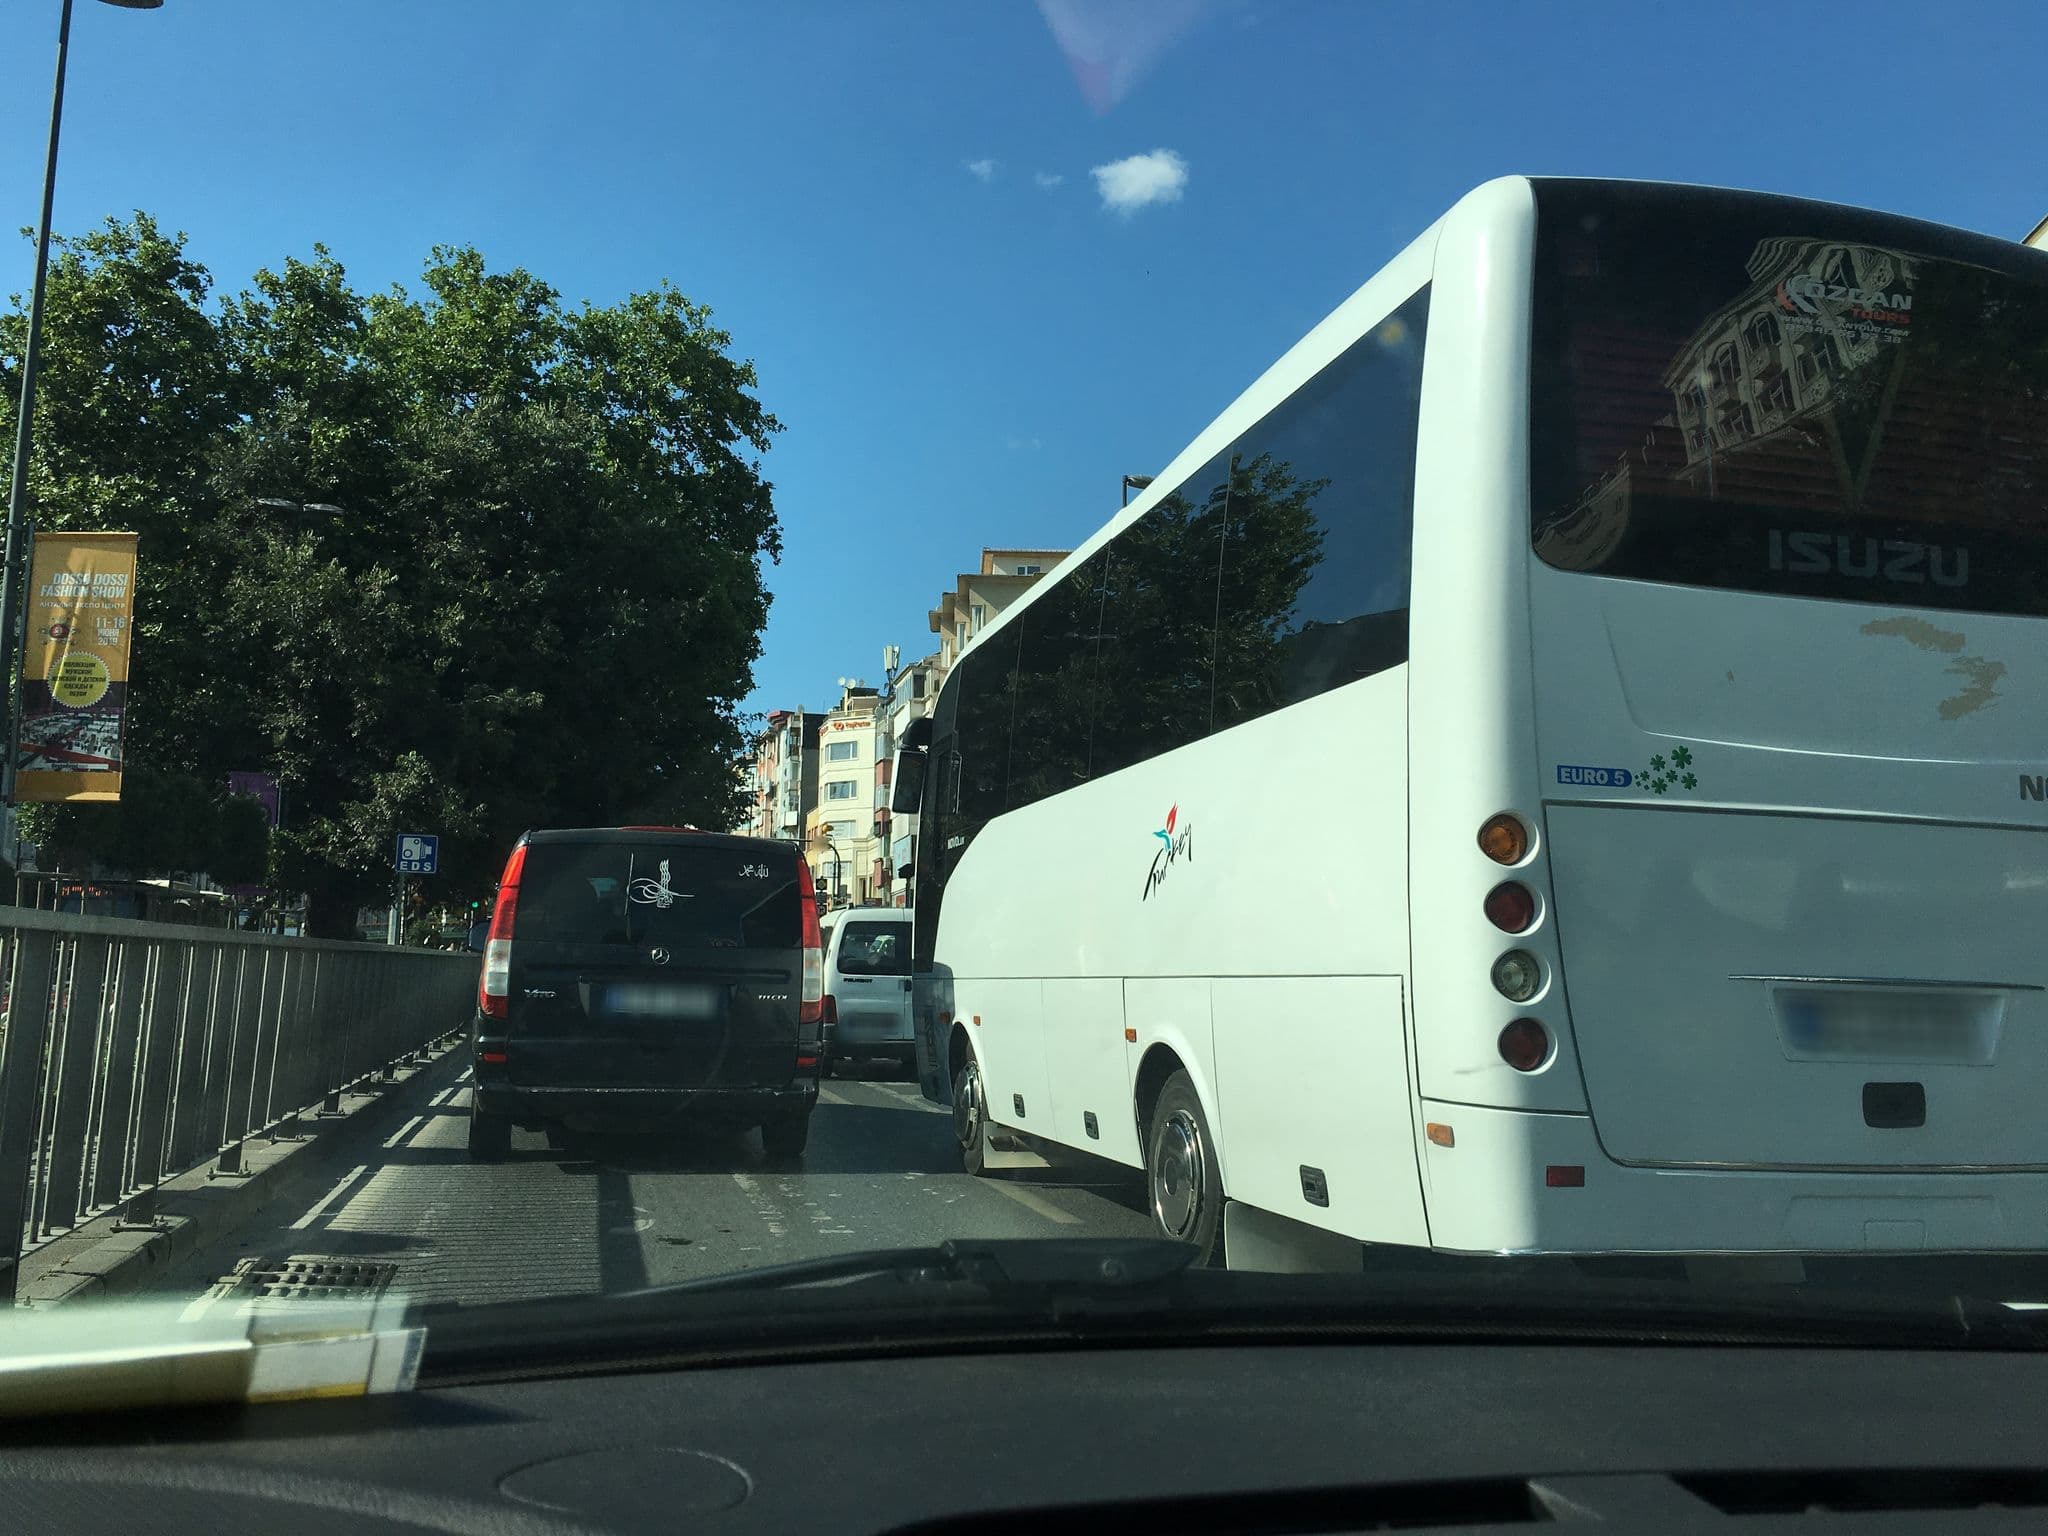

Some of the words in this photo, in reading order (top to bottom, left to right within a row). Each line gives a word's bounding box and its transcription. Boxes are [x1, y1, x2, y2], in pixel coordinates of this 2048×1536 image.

[1768, 529, 1969, 587] ISUZU
[53, 573, 91, 585] DOSSO
[93, 574, 129, 586] DOSSI
[40, 585, 90, 597] FASHION
[92, 586, 126, 598] SHOW
[1560, 767, 1609, 785] EURO
[1613, 769, 1625, 786] 5
[2019, 774, 2048, 802] N
[399, 861, 432, 872] EDS
